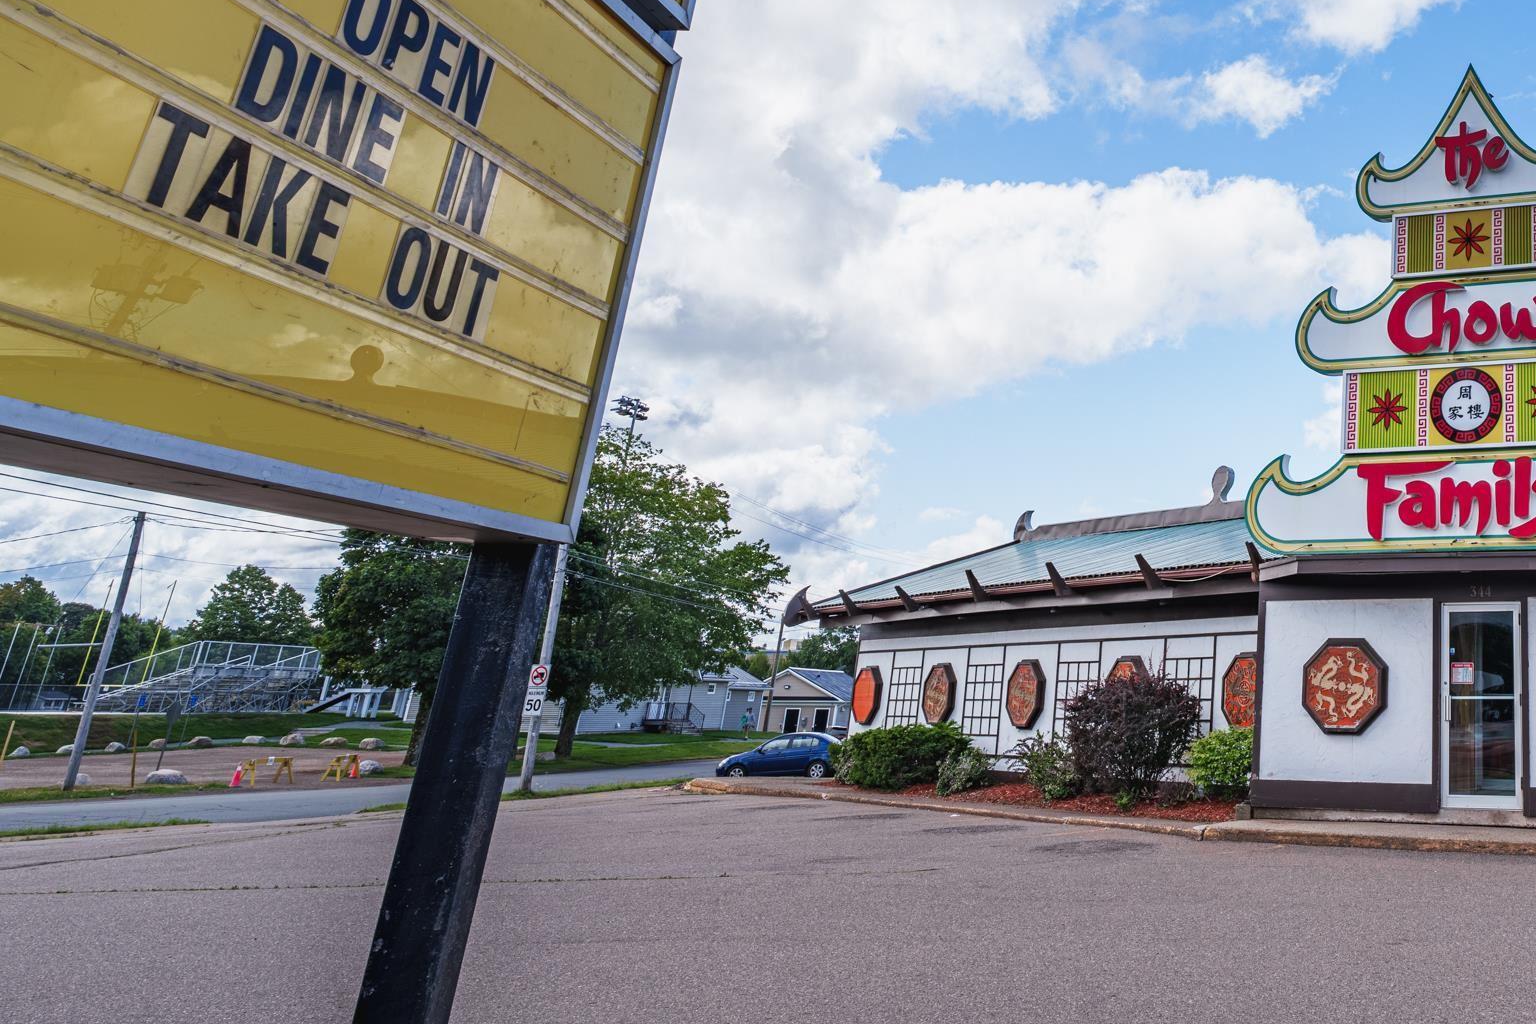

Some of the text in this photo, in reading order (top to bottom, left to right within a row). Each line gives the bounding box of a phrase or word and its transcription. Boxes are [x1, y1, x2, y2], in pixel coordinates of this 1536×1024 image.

[238, 23, 499, 234] DINE IN
[1434, 121, 1510, 191] The
[146, 102, 500, 337] TAKE OUT
[1470, 585, 1492, 597] 344
[525, 699, 541, 711] 50
